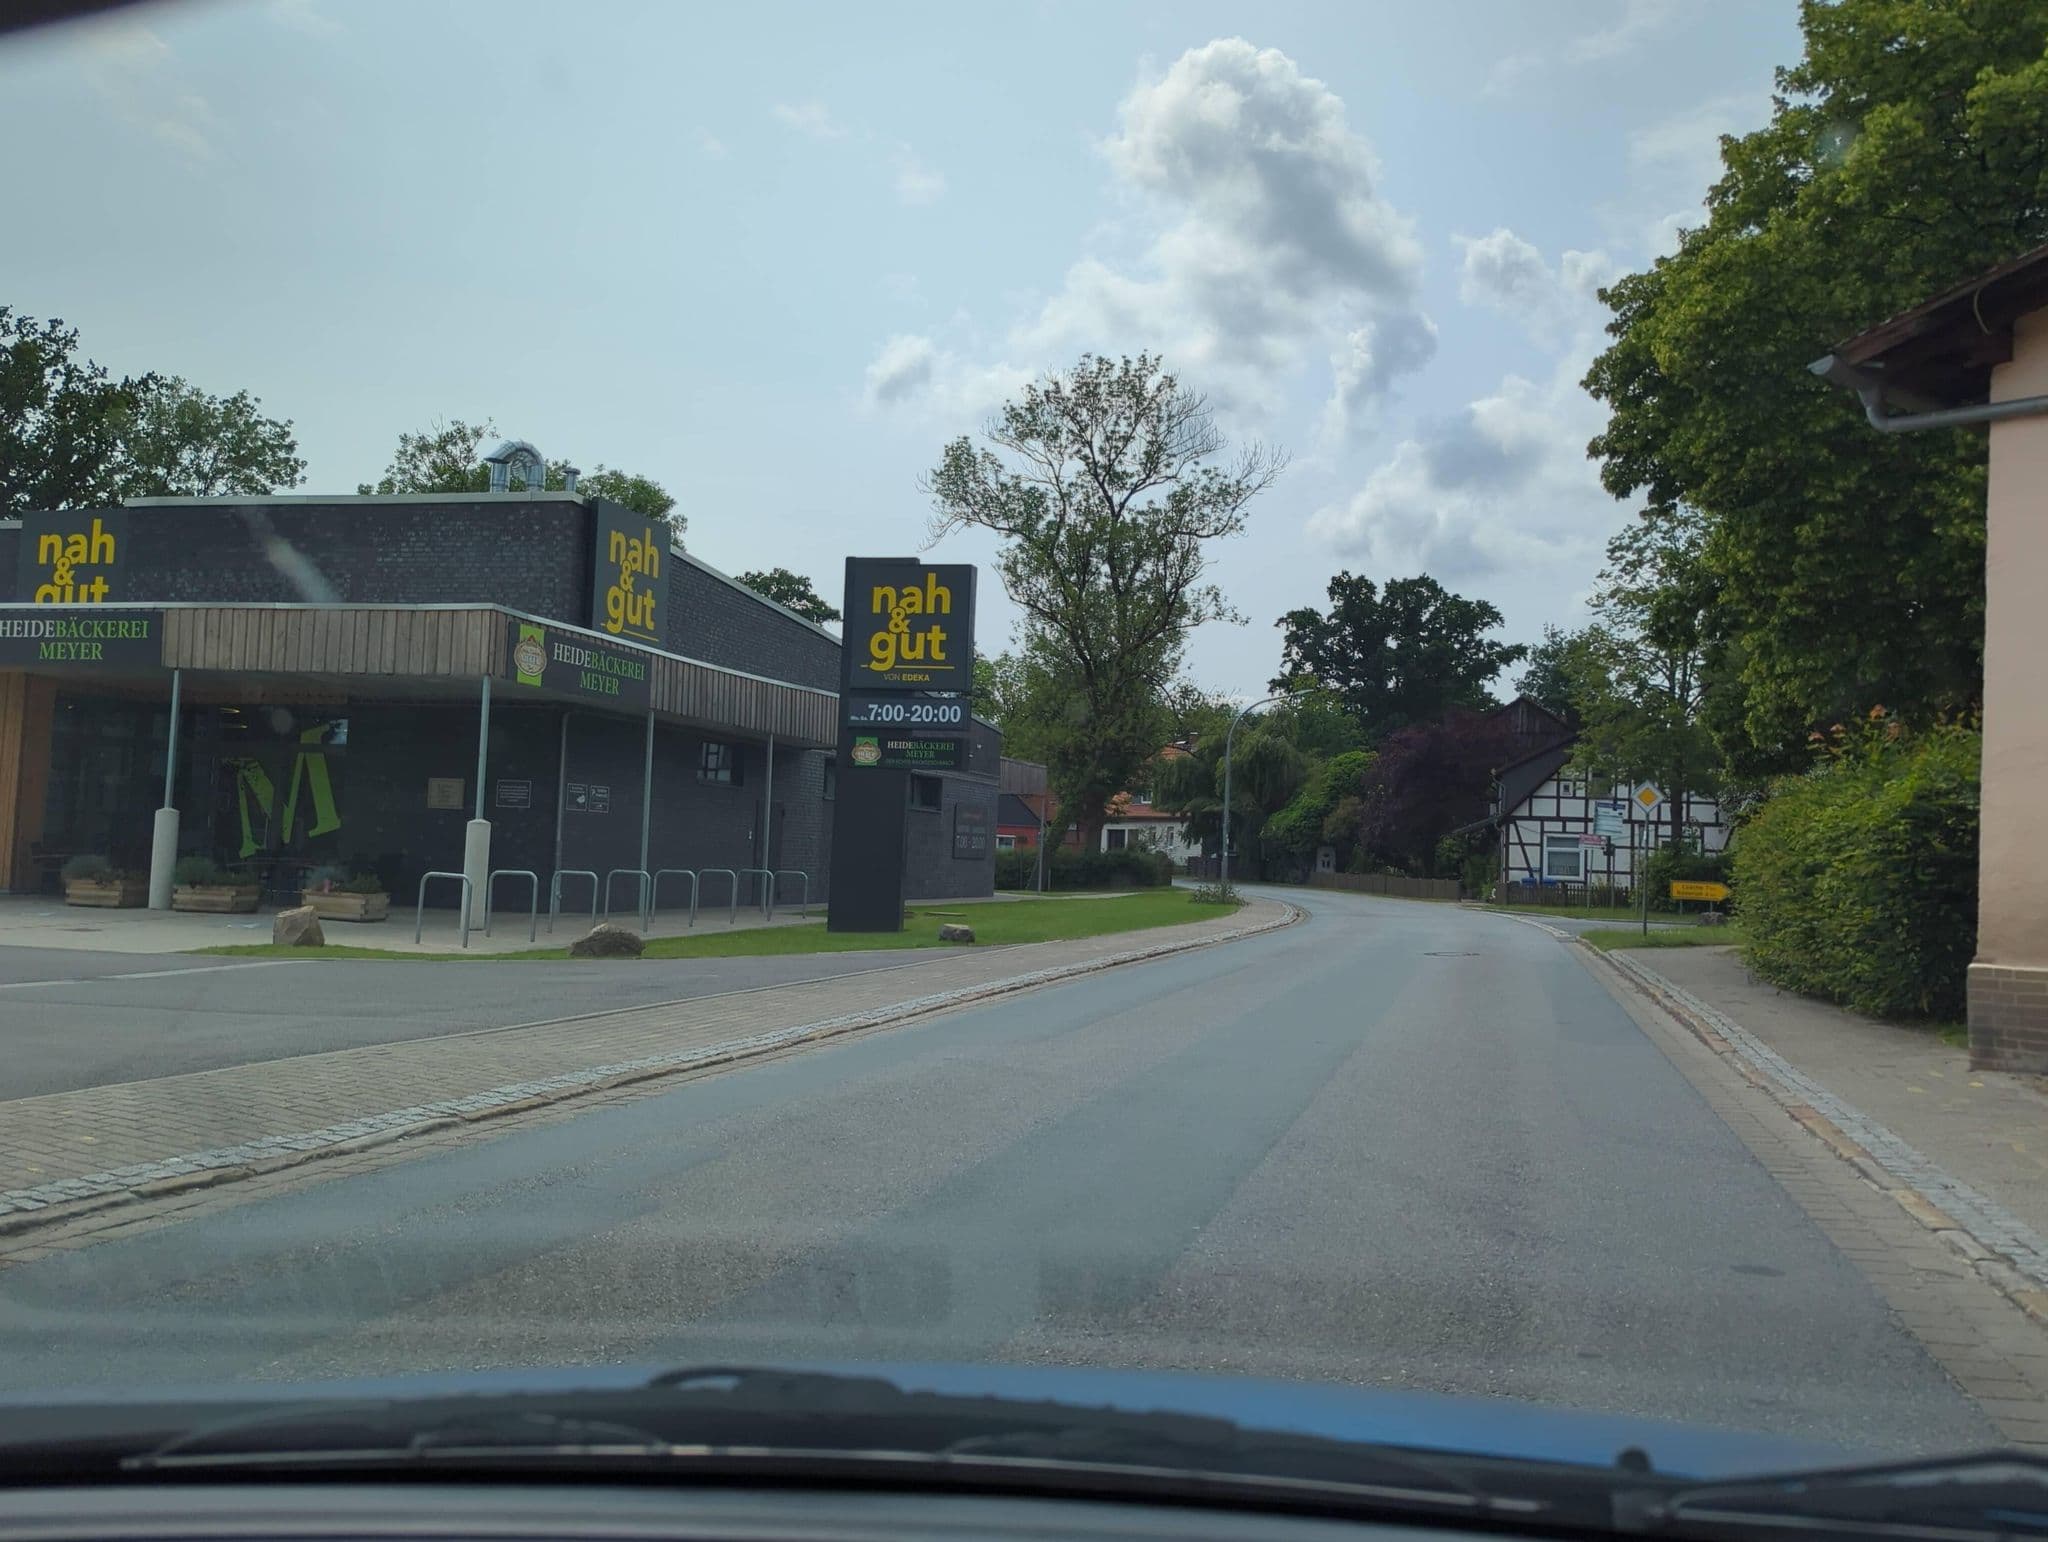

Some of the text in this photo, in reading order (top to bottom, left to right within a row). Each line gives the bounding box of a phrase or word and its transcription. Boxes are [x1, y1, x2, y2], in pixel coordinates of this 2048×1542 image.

[38, 518, 115, 565] nah
[609, 527, 659, 578] nah
[54, 557, 76, 586] &
[620, 560, 635, 592] &
[871, 572, 951, 614] nah
[606, 588, 656, 634] gut
[888, 607, 911, 633] &
[0, 616, 149, 638] HEIDEBÄCKEREI
[39, 641, 104, 660] MEYER
[870, 623, 947, 671] gut
[554, 642, 645, 680] HEIDEBÄCKEREI
[580, 671, 619, 695] MEYER
[902, 673, 931, 682] EDEKA
[867, 703, 962, 723] 7:00-20:00
[887, 739, 955, 751] HEIDEBÄCKEREI
[906, 749, 936, 759] MEYER
